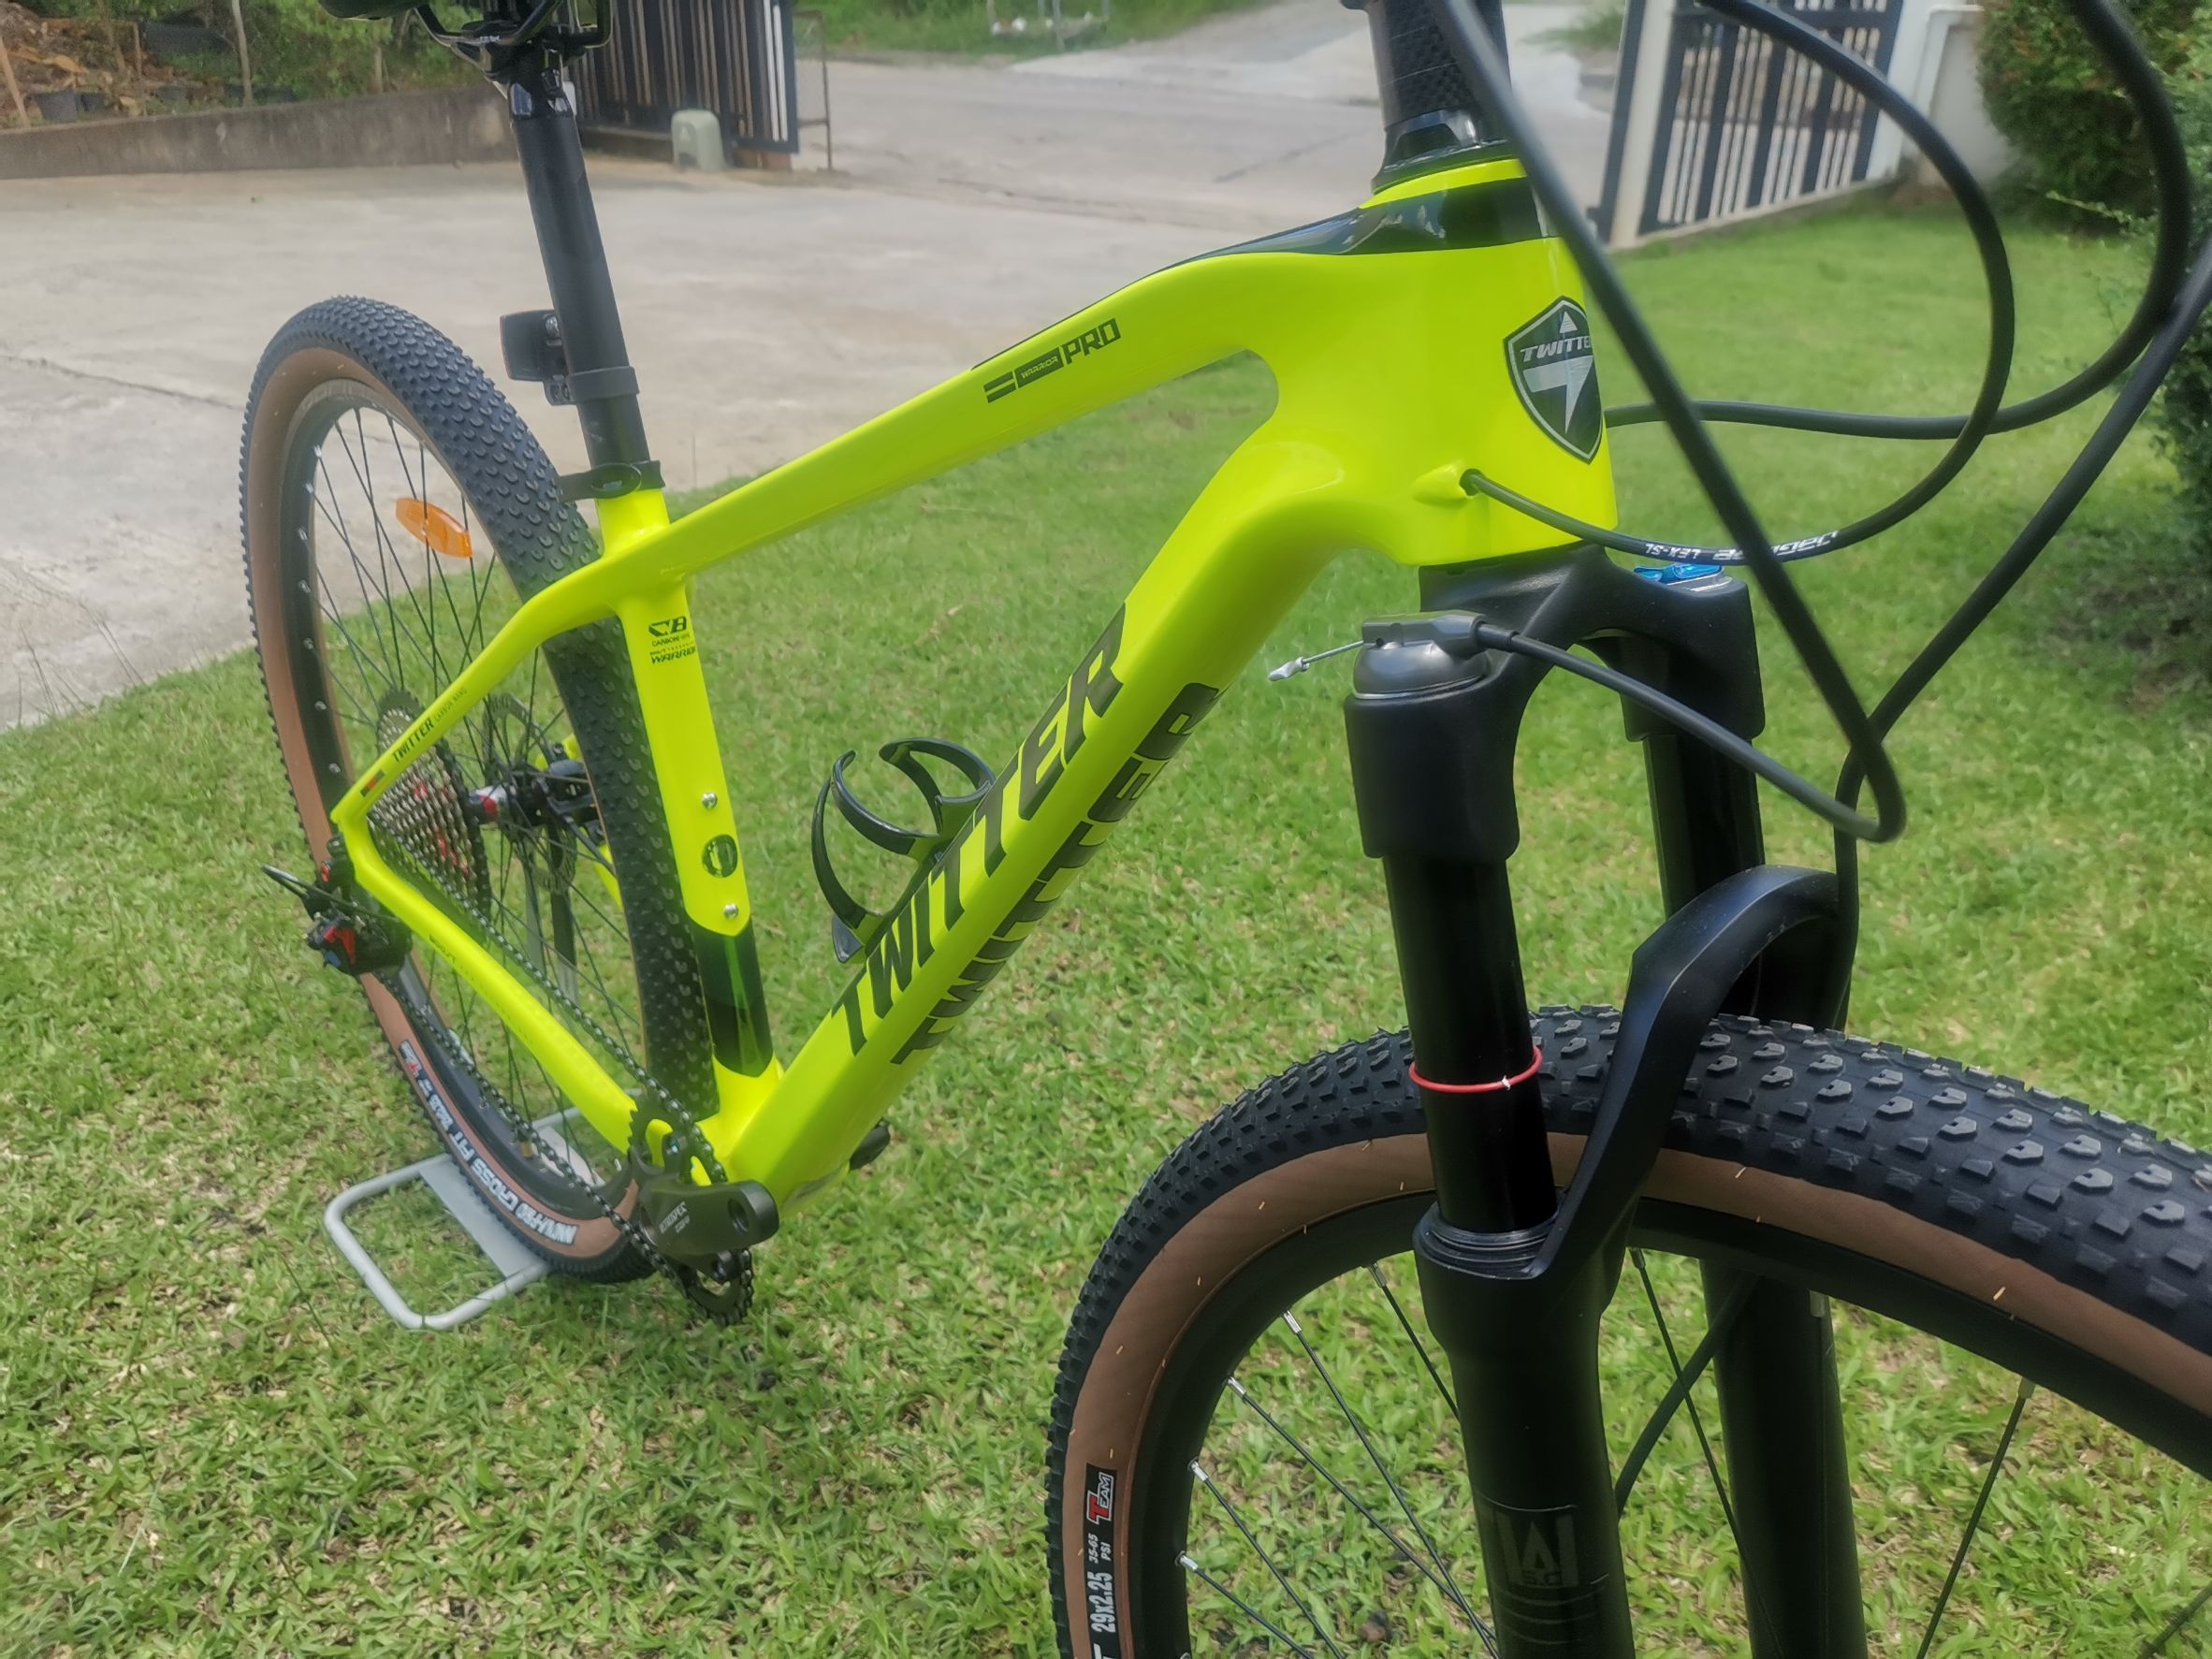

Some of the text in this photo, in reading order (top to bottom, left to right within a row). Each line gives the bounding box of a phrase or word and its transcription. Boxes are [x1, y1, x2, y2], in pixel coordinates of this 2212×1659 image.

[1020, 318, 1121, 379] WARRIOR PRO
[1520, 335, 1592, 363] TWITTE
[1645, 543, 1701, 560] LEX-SL
[392, 718, 435, 763] TWITTER
[831, 602, 1126, 1055] TWITTER
[1088, 1533, 1099, 1564] 35-65
[1100, 1541, 1113, 1561] PSI
[1087, 1571, 1116, 1633] 29x2.25
